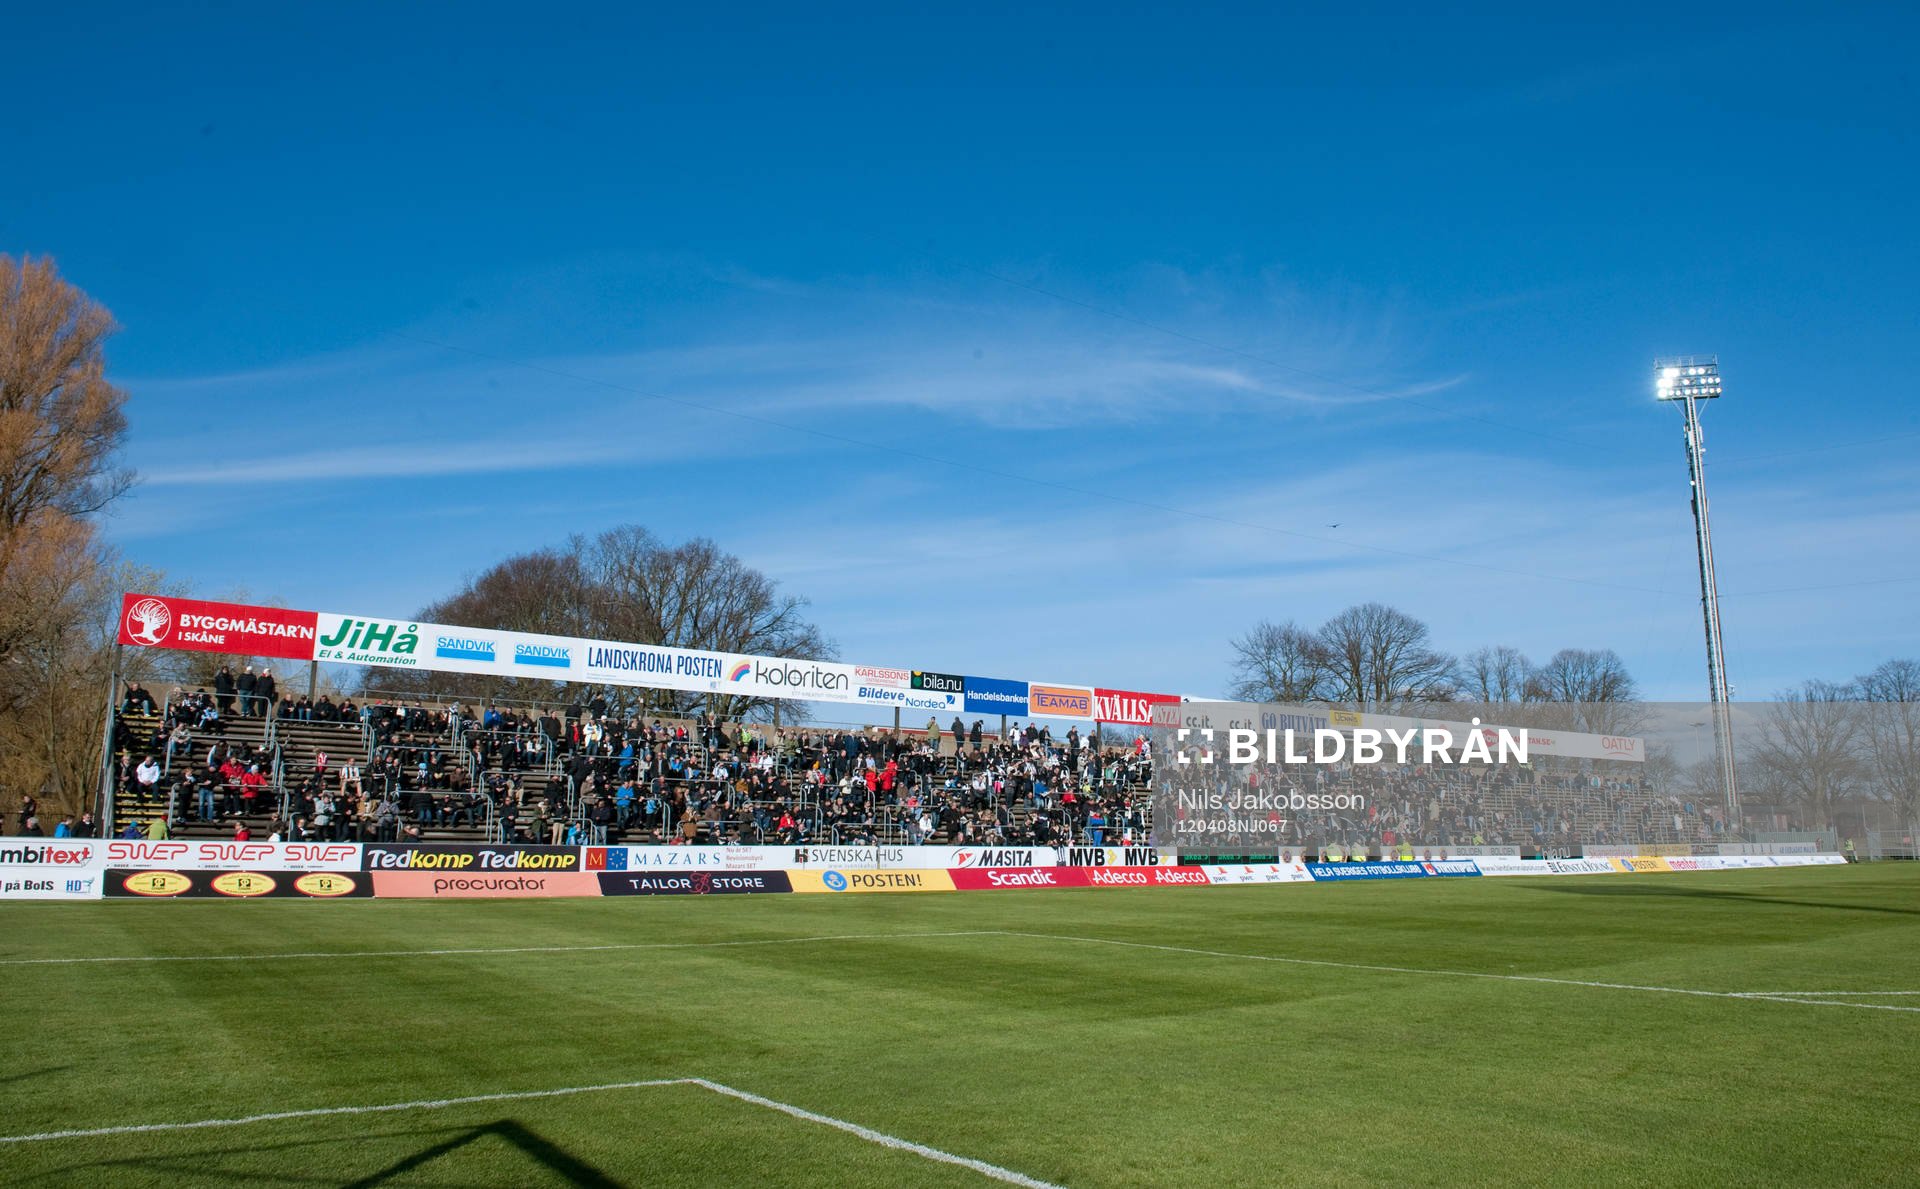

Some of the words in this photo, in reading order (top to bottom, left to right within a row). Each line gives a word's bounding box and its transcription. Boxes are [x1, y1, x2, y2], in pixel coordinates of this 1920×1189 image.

[178, 632, 182, 641] I
[184, 631, 225, 645] SKÅNE
[437, 637, 495, 652] SANDVIK
[335, 651, 344, 660] &
[347, 652, 417, 666] Automation
[515, 644, 570, 659] SANDVIK
[588, 647, 672, 675] LANDSKRONA
[677, 655, 723, 679] POSTEN
[755, 660, 849, 691] koloriten
[855, 668, 910, 681] KARLSSONS
[923, 672, 962, 691] bila.nu
[858, 687, 905, 701] Bildeve
[967, 690, 1029, 704] Handelsbanken
[1034, 693, 1089, 710] TEAMAB
[905, 698, 946, 709] Nordea
[1602, 737, 1635, 751] OATLY
[108, 843, 188, 860] SWEP
[199, 844, 275, 861] SWEP
[284, 846, 356, 861] SWEP
[368, 849, 474, 868] Tedkomp
[634, 853, 721, 865] MAZARS
[812, 849, 873, 863] SVENSKA
[875, 849, 903, 863] HUS
[978, 850, 1033, 867] MASITA
[1069, 849, 1105, 867] MVB
[1125, 849, 1159, 867] MVB
[478, 850, 576, 869] Tedkomp
[629, 878, 691, 890] TAILOR
[712, 877, 764, 890] STORE
[852, 873, 922, 888] POSTEN!
[987, 869, 1057, 886] Scandic
[1092, 869, 1147, 885] Adecco
[1154, 868, 1206, 884] Adecco
[66, 880, 82, 891] HD
[433, 876, 546, 893] procurator
